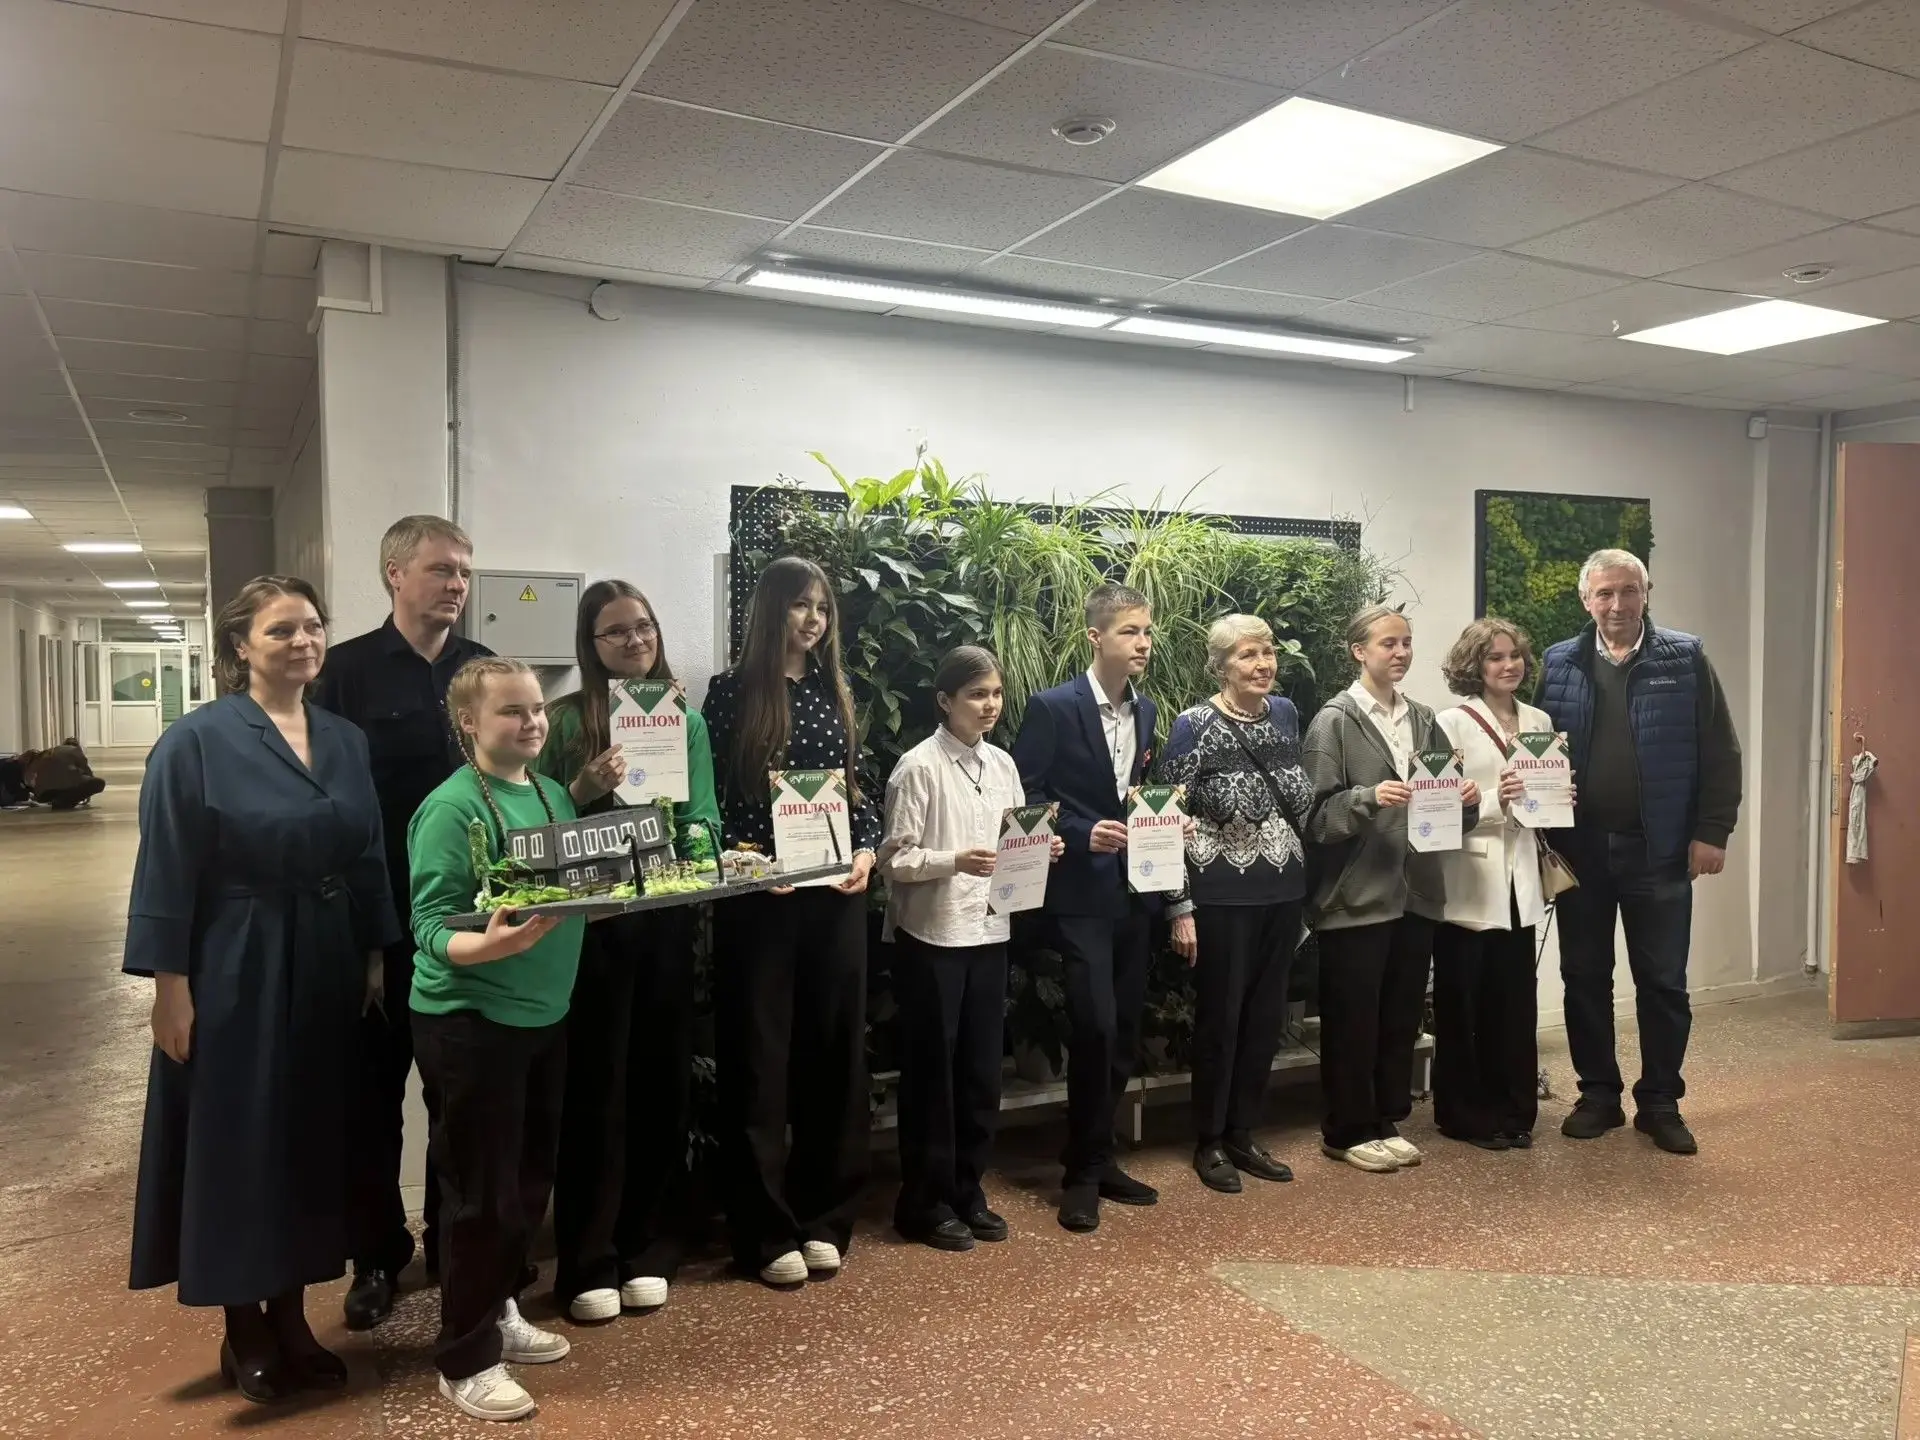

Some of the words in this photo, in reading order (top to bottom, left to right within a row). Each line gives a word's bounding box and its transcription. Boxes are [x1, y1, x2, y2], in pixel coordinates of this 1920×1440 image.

[616, 715, 681, 730] ДИПЛОМ
[1513, 760, 1565, 770] ДИПЛОМ
[1412, 778, 1458, 791] ДИПЛОМ
[778, 802, 842, 817] ДИПЛОМ
[1132, 815, 1180, 829] ДИПЛОМ
[1001, 834, 1049, 850] ДИПЛОМ
